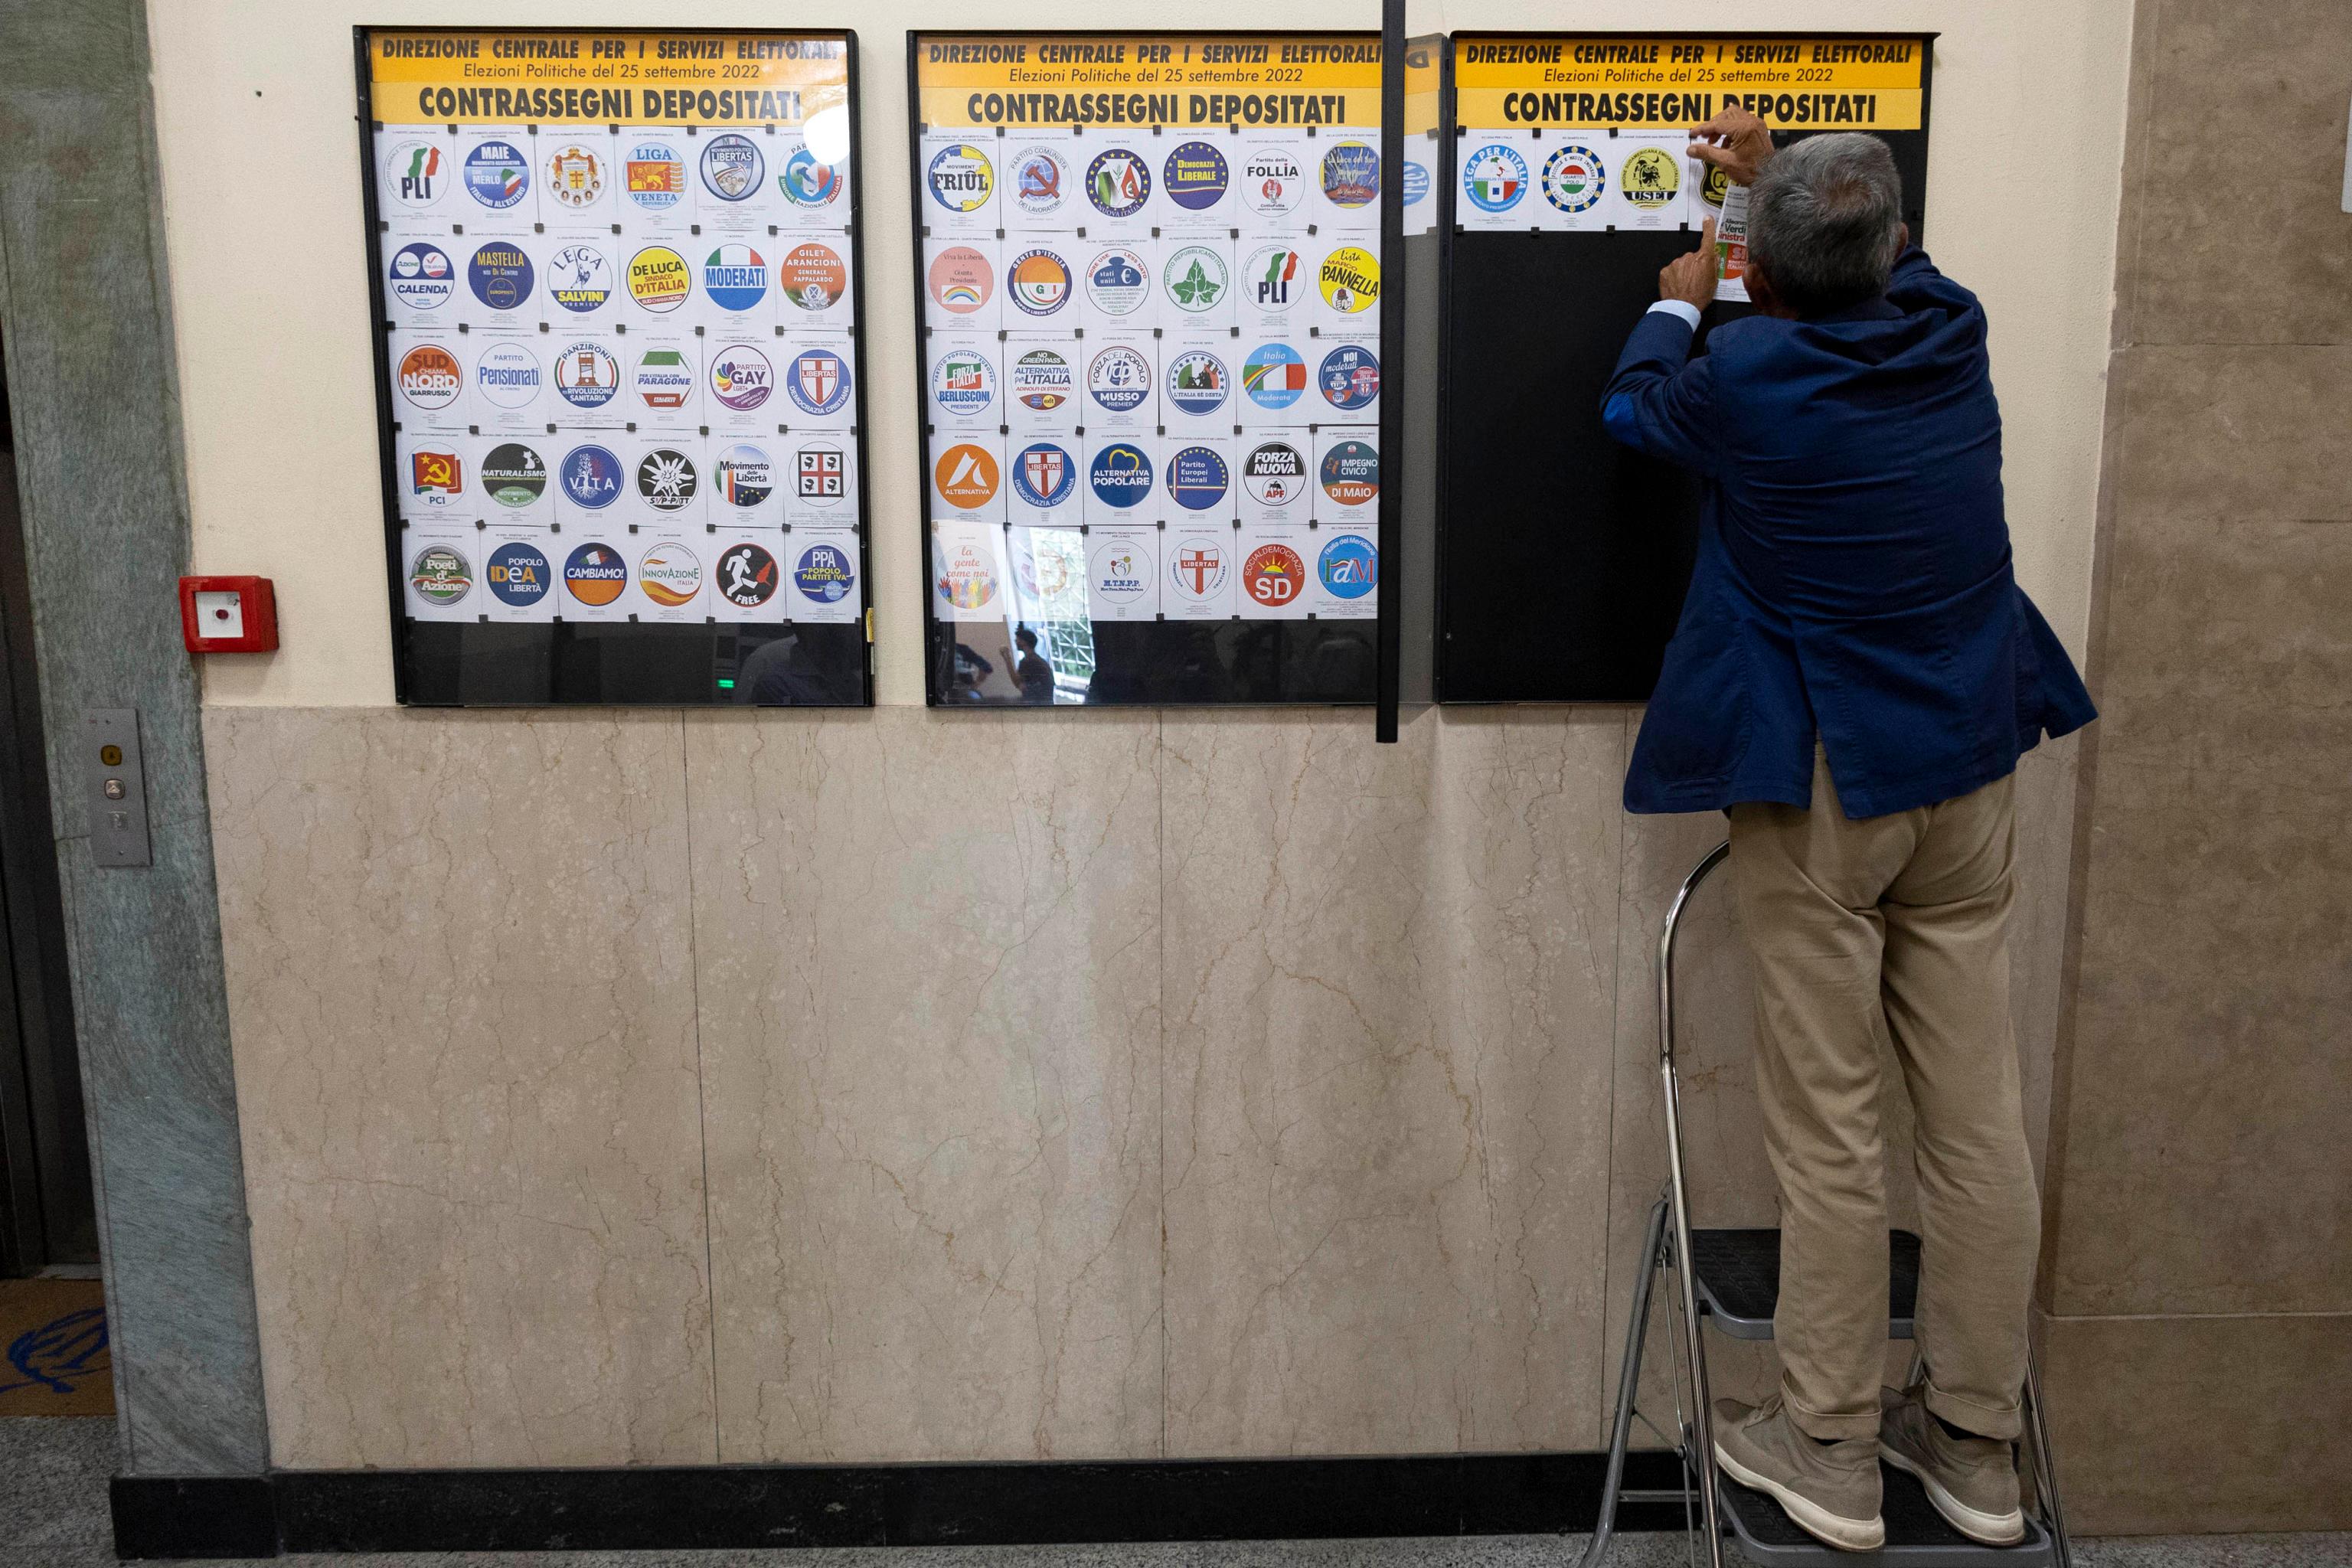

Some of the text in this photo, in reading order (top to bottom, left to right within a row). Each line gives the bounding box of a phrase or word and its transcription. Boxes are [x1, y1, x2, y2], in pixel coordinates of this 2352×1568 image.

[383, 39, 838, 60] DIREZIONE CENTRALE PER I SERVIZI ELETTORALI
[929, 44, 1381, 64] DIREZIONE CENTRALE PER I SERVIZI ELETTORALI
[1466, 45, 1912, 64] DIREZIONE CENTRALE PER I SERVIZI ELETTORALI
[464, 64, 760, 78] Elezioni Politiche del 25 settembre 2022
[1010, 68, 1302, 82] Elezioni Politiche del 25 settembre 2022
[1544, 68, 1833, 82] Elezioni Politiche del 25 settembre 2022
[419, 87, 800, 119] CONTRASSEGNI DEPOSITATI
[968, 93, 1345, 124] CONTRASSEGNI DEPOSITATI
[1504, 92, 1711, 122] CONTRASSEGNI
[481, 146, 509, 159] MAIE
[636, 149, 672, 160] LIGA
[711, 152, 752, 162] LIBERTAS
[1011, 148, 1067, 170] PARTITO COMUNISTA
[1178, 159, 1215, 168] DEMOCRAZIA
[1465, 159, 1478, 190] LEGA
[1478, 146, 1500, 160] PER
[1504, 149, 1527, 189] L'ITALIA
[472, 175, 500, 185] MERLO
[934, 170, 988, 191] FRIÛL
[1178, 169, 1216, 181] LIBERALE
[401, 177, 431, 199] PLI
[779, 178, 795, 201] UNIONE
[828, 176, 842, 203] ITALIANA
[470, 187, 525, 207] ITALIANI ALL'ESTERO
[633, 193, 677, 201] VENETA
[795, 200, 828, 208] NAZIONALE
[1725, 224, 1746, 235] Verdi
[477, 252, 524, 266] MASTELLA
[554, 247, 603, 270] LEGA
[1013, 250, 1066, 269] GENTE D'ITALIA
[632, 260, 683, 276] DE LUCA
[1327, 260, 1358, 271] MARCO
[705, 268, 765, 287] MODERATI
[1322, 265, 1379, 296] PANNELLA
[397, 285, 448, 294] CALENDA
[635, 279, 685, 295] D'ITALIA
[1259, 281, 1287, 303] PLI
[558, 291, 604, 302] SALVINI
[561, 344, 611, 361] PANZIRONI
[1264, 351, 1285, 360] Italia
[1344, 352, 1357, 362] NOI
[412, 354, 449, 368] SUD
[1093, 351, 1146, 383] FORZA DEL POPOLO
[1325, 361, 1357, 373] moderati
[480, 367, 539, 386] Pensionati
[952, 364, 975, 377] FORZA
[403, 372, 459, 388] NORD
[730, 371, 766, 384] GAY
[952, 374, 976, 388] ITALIA
[789, 385, 850, 414] DEMOCRAZIA CRISTIANA
[939, 390, 990, 402] BERLUSCONI
[1099, 393, 1139, 401] MUSSO
[1254, 452, 1295, 463] FORZA
[719, 461, 769, 471] Movimento
[1253, 463, 1296, 475] NUOVA
[1341, 467, 1367, 475] CIVICO
[736, 472, 767, 482] Libertà
[1093, 477, 1150, 486] POPOLARE
[1014, 478, 1076, 506] DEMOCRAZIA CRISTIANA
[1266, 490, 1285, 498] APF
[1331, 488, 1371, 498] DI MAIO
[429, 496, 446, 505] PCI
[426, 559, 457, 570] Poeti
[508, 558, 543, 567] POPOLO
[812, 551, 836, 567] PPA
[954, 559, 980, 568] gente
[567, 568, 624, 579] CAMBIAMO!
[421, 582, 462, 591] Azione
[509, 583, 542, 593] LIBERTÀ
[1255, 578, 1292, 599] SD
[735, 594, 760, 606] FREE
